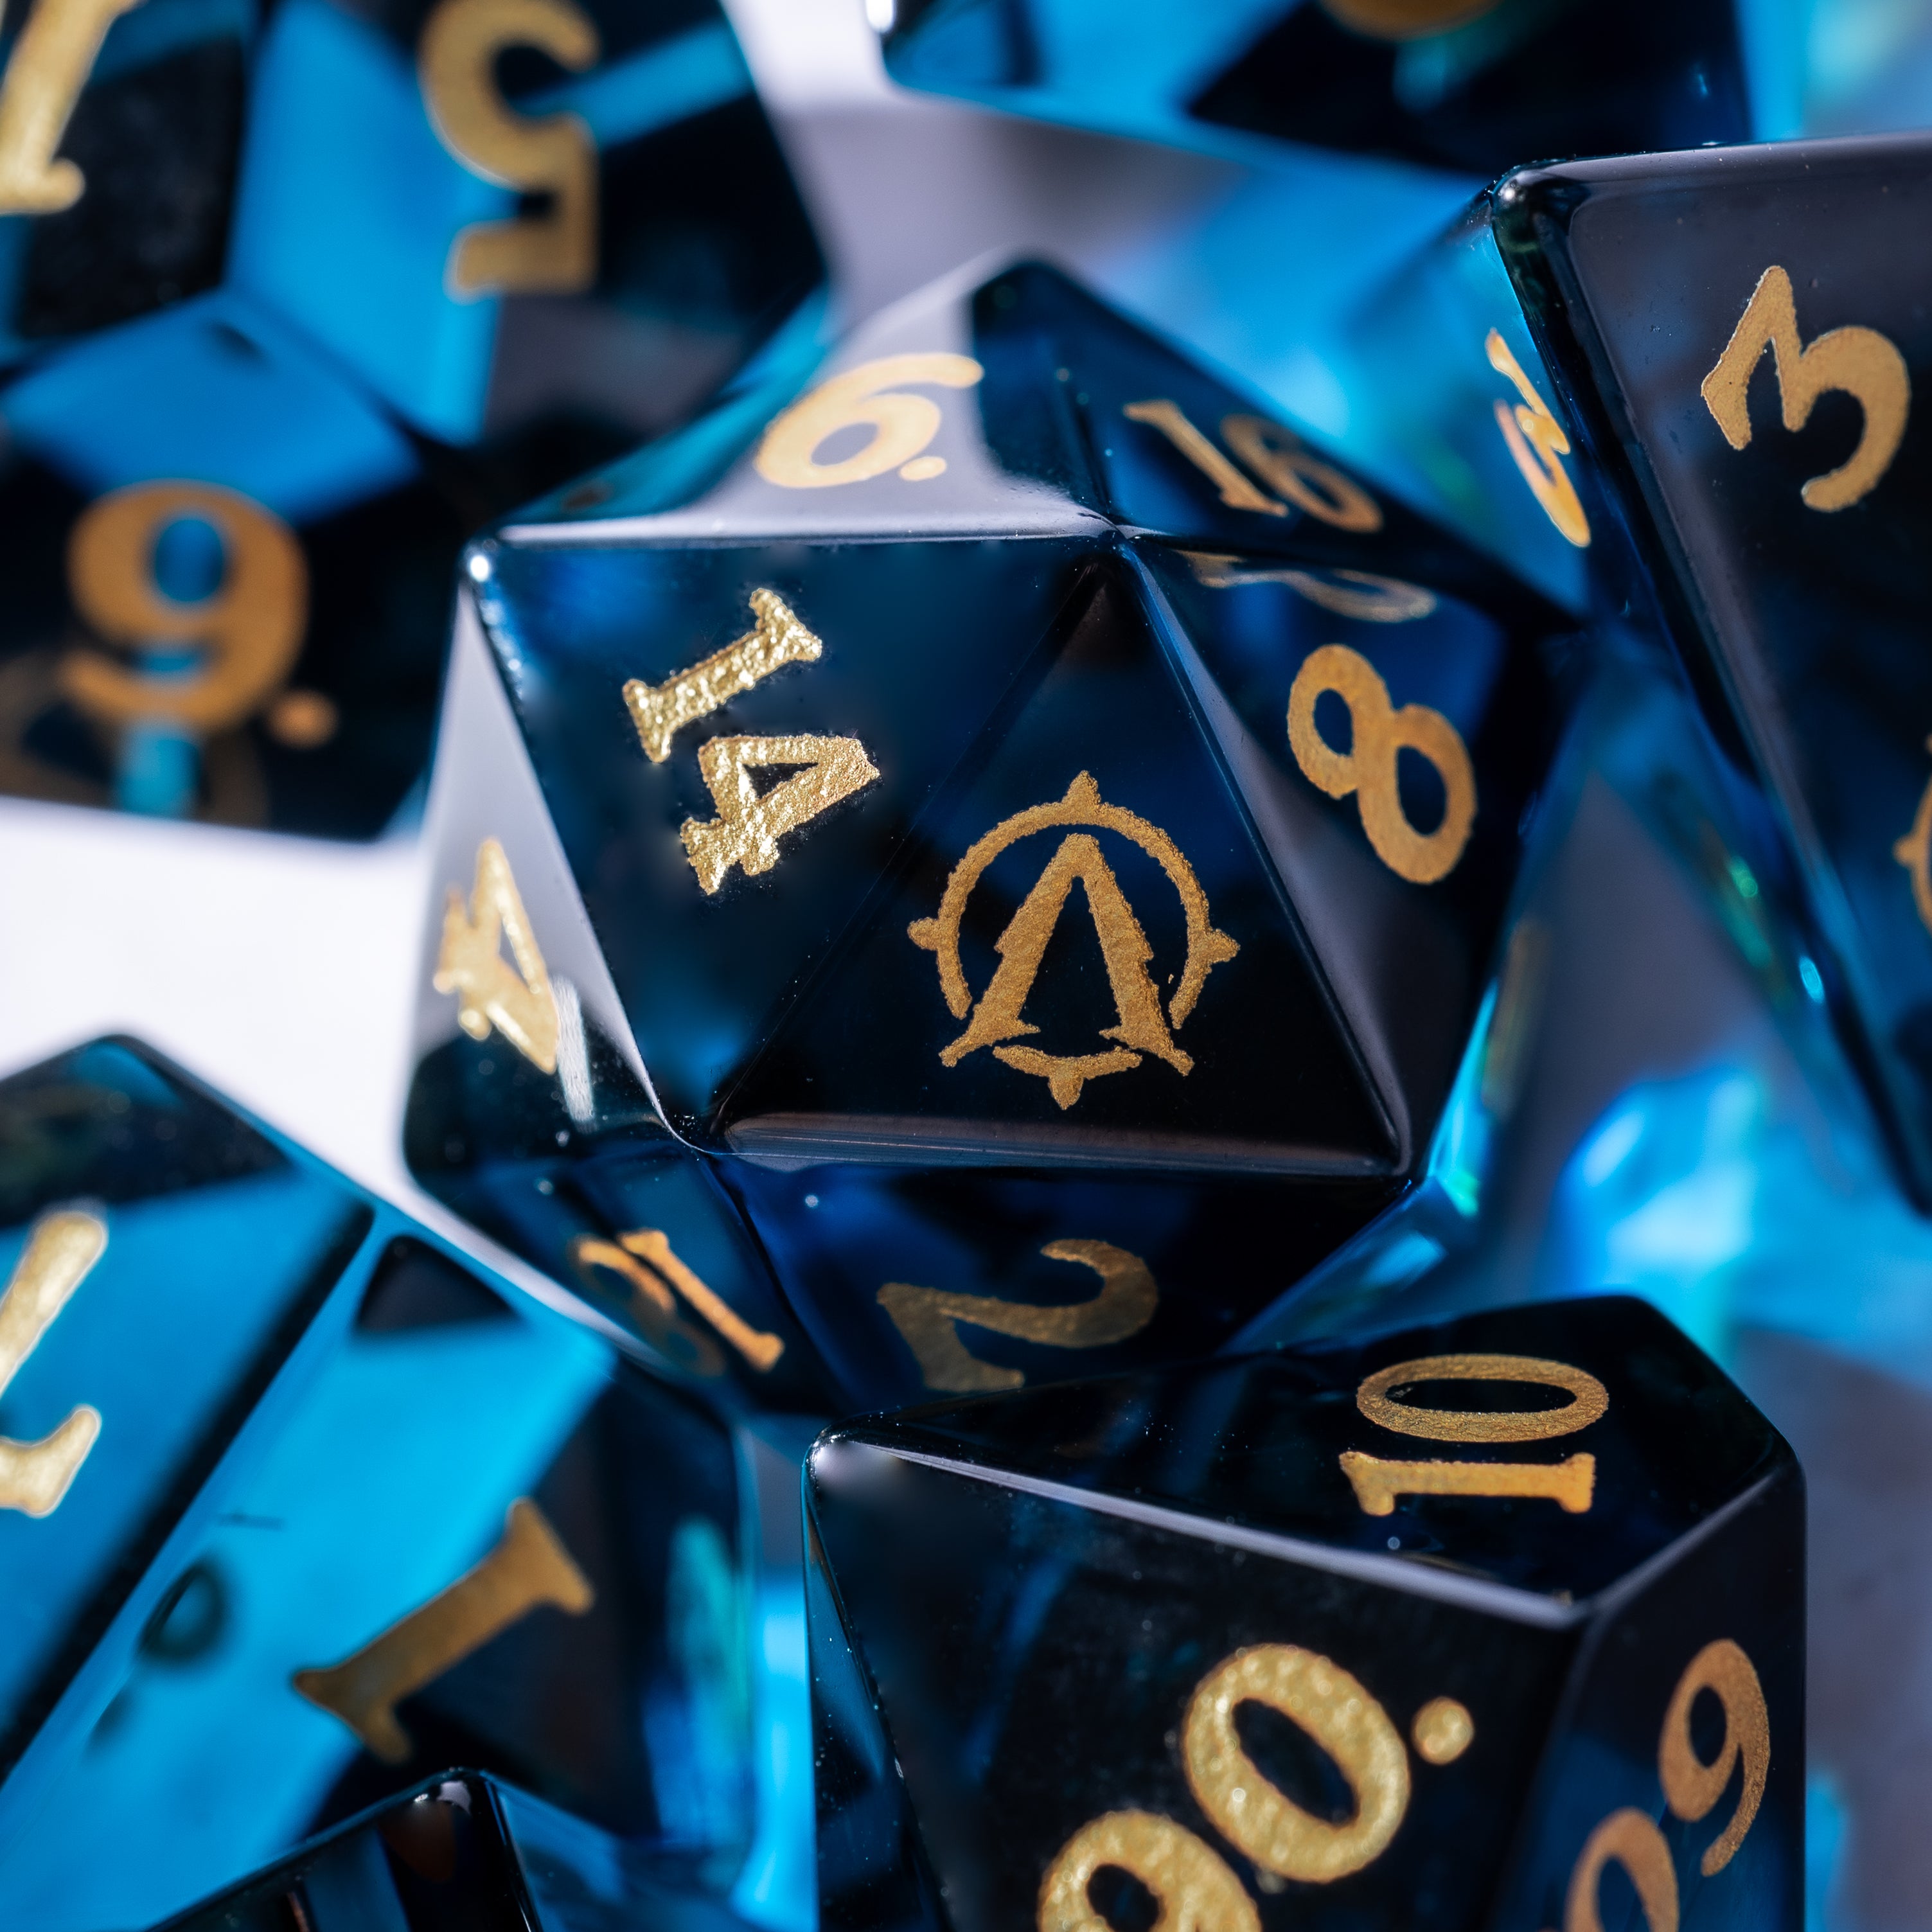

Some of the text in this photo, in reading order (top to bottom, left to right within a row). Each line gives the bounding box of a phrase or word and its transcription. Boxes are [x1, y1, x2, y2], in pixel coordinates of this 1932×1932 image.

[1122, 397, 1383, 535] 16
[1701, 265, 1911, 512] 3
[621, 587, 880, 896] 14
[1287, 644, 1478, 884] 8
[876, 1238, 1157, 1392] 2
[1339, 1353, 1610, 1517] 10
[292, 1496, 594, 1764] 1
